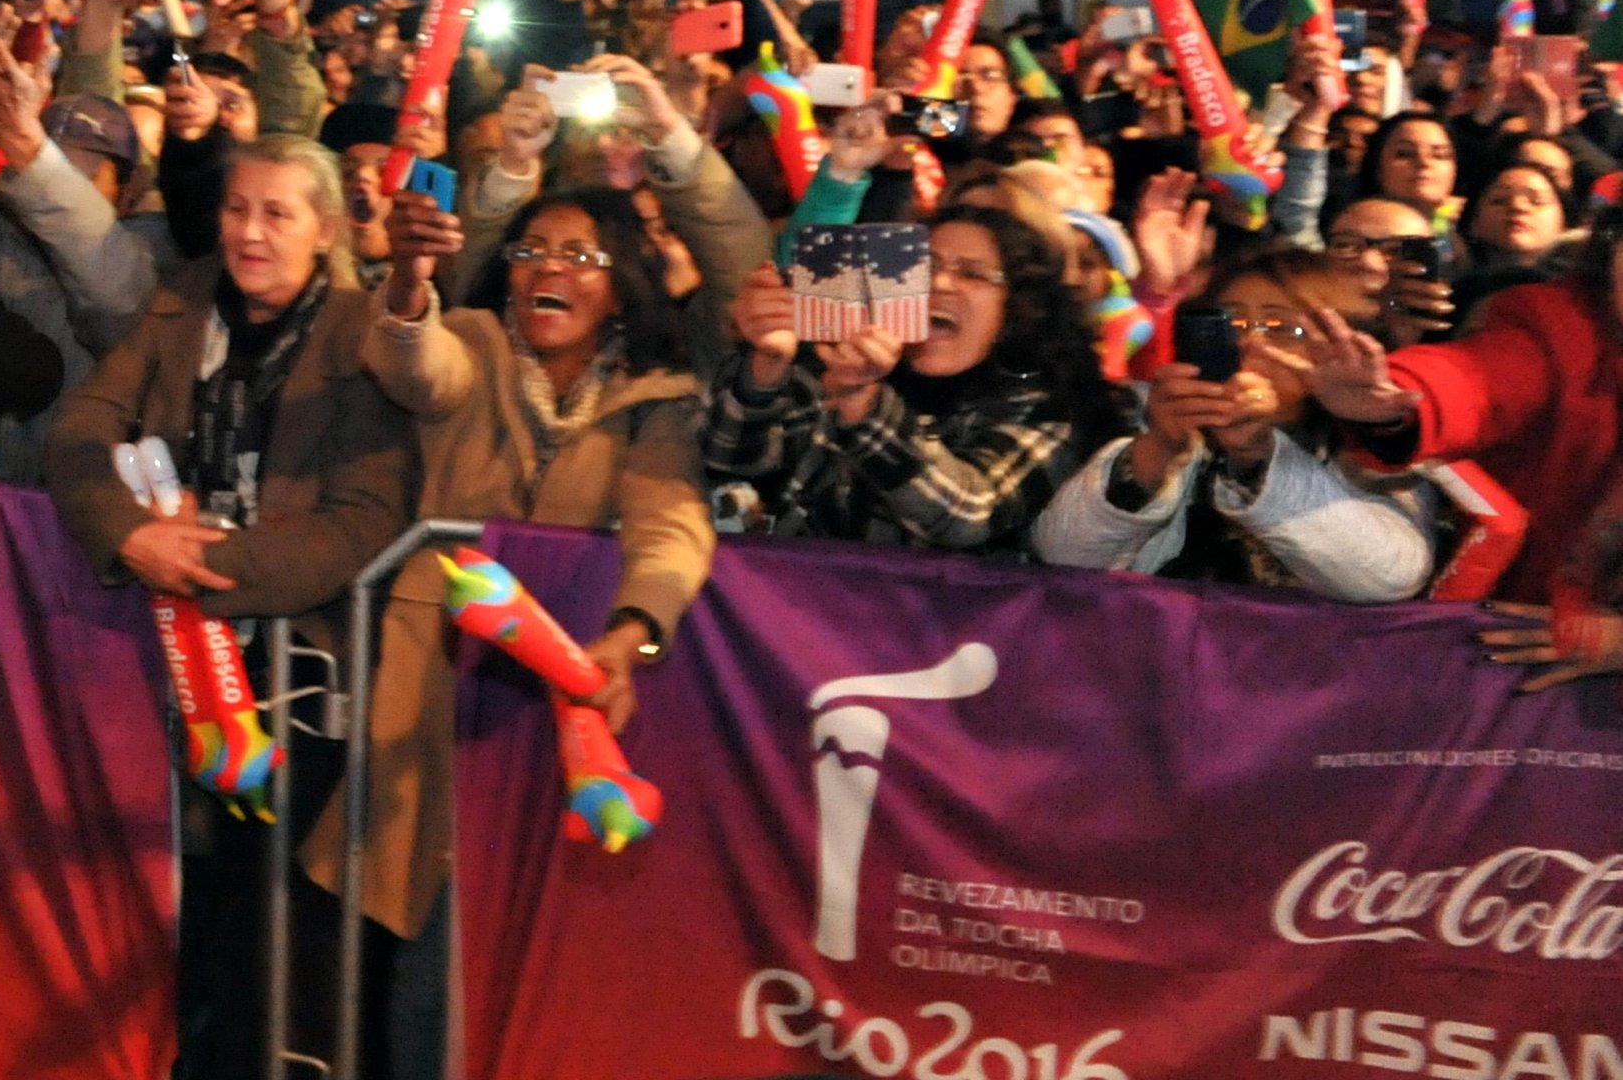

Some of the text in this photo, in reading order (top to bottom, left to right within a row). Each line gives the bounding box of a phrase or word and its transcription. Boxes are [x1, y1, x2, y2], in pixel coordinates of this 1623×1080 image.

[1176, 31, 1227, 127] Bradesco
[154, 607, 198, 714] Bradesco
[203, 620, 244, 704] adesco
[892, 908, 1066, 954] DA TOCHA
[896, 873, 1144, 924] REVEZAMENTO
[1272, 841, 1623, 959] Coca-Cola
[739, 969, 1127, 1080] Rio2016
